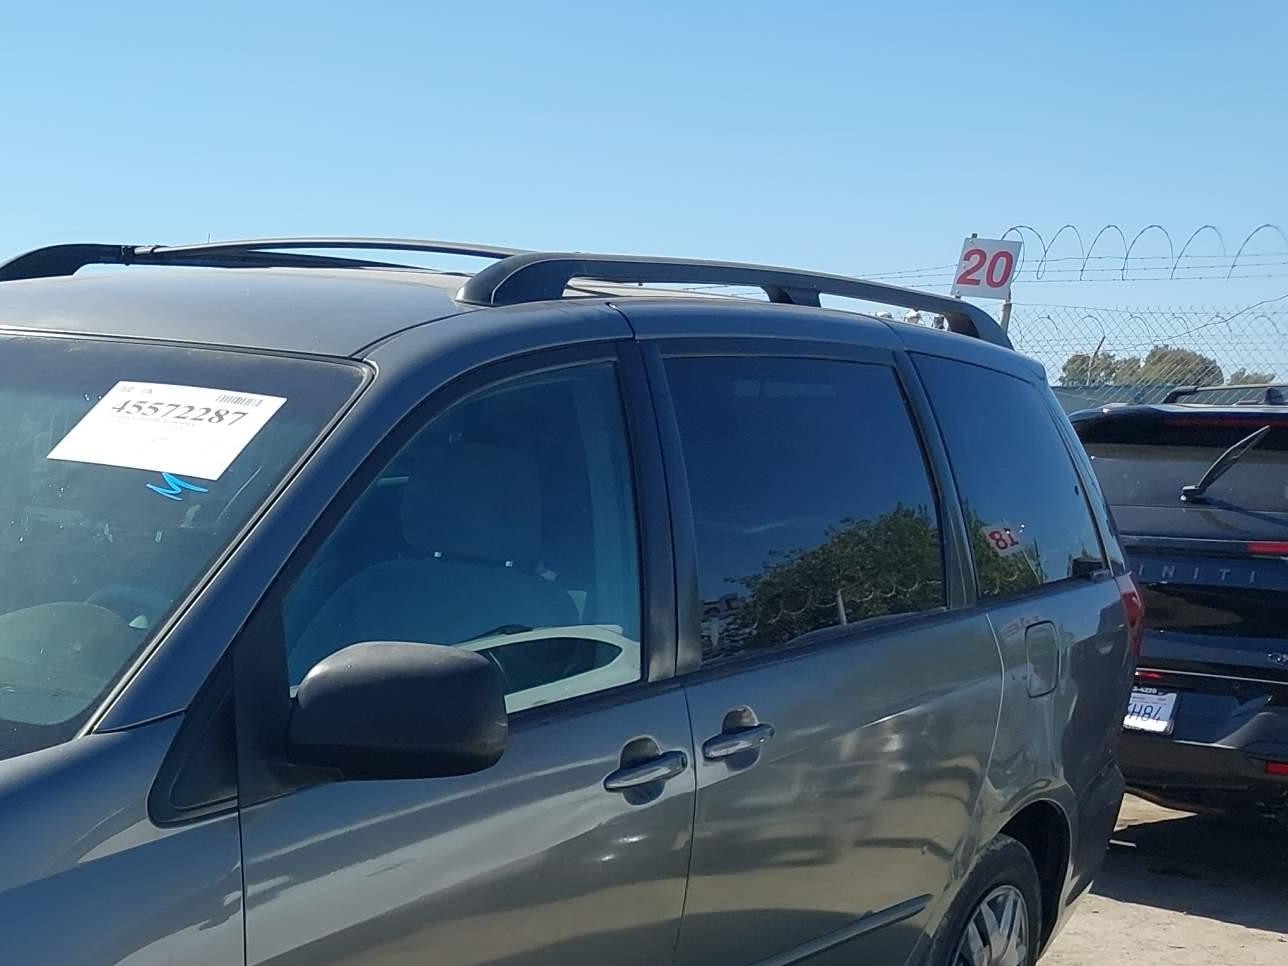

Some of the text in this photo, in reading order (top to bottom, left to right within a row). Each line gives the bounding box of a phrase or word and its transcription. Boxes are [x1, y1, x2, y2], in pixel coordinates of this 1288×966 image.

[956, 248, 1013, 288] 20
[112, 399, 249, 426] 45572287
[1138, 564, 1256, 583] INITI
[1128, 703, 1162, 722] H84
